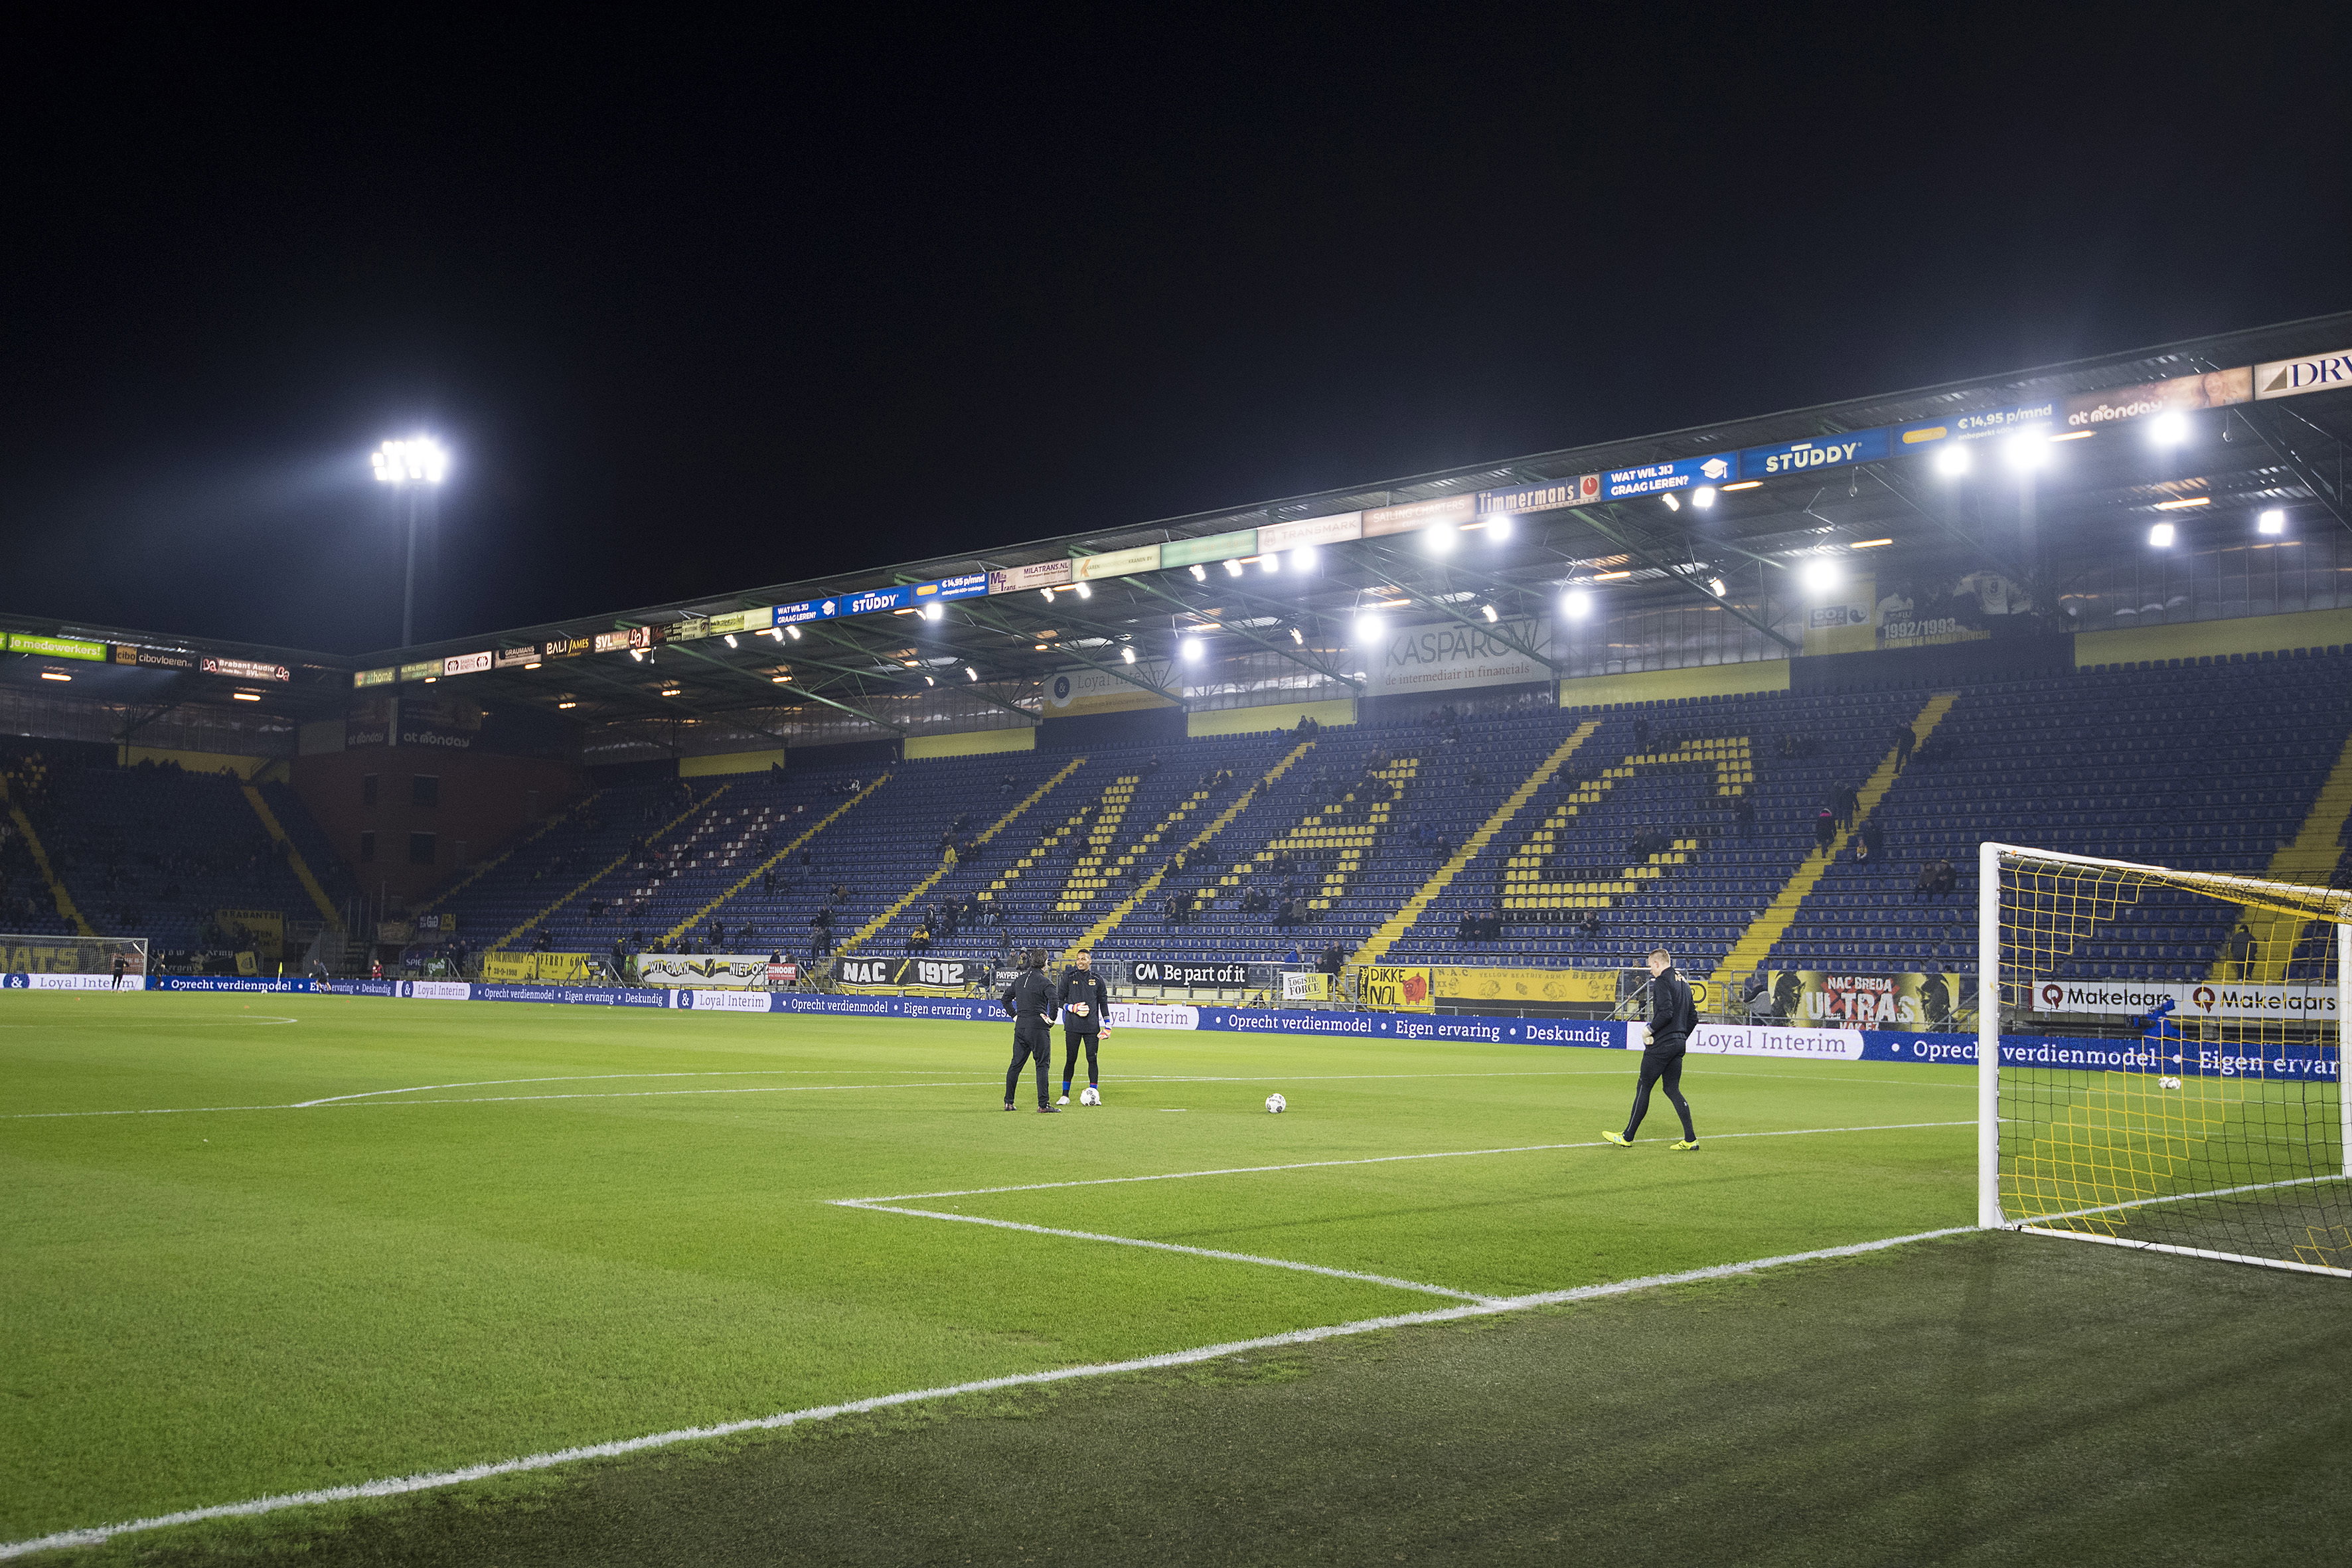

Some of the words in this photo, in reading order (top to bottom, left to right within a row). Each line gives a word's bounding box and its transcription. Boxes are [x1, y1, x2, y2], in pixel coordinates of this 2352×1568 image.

[1969, 412, 2003, 428] 14,95
[2006, 404, 2053, 424] p/mnd
[2069, 412, 2088, 425] at
[2090, 402, 2163, 424] monday
[1611, 471, 1636, 483] WAT
[1637, 467, 1657, 479] WIL
[1658, 465, 1673, 477] JIJ
[1611, 481, 1648, 496] GRAAG
[1649, 475, 1689, 490] LEREN?
[1478, 484, 1574, 513] Timmermans
[1373, 508, 1412, 522] SAILING
[1415, 500, 1465, 516] CHARTERS
[1282, 520, 1357, 539] TRANSMARK
[1024, 562, 1068, 574] MILATRANS.NL
[947, 578, 963, 588] 14,95
[964, 574, 985, 586] p/mnd
[999, 580, 1016, 591] Trans
[777, 606, 790, 615] WAT
[791, 604, 801, 613] WIL
[777, 614, 797, 624] GRAAG
[797, 611, 817, 621] LEREN?
[1883, 617, 1956, 639] 1992/1993
[10, 638, 21, 648] je
[24, 640, 100, 656] medewerkers!
[505, 646, 534, 656] GRAUMANS
[546, 641, 566, 655] BALI
[569, 639, 589, 653] JAMES
[595, 635, 613, 649] SVL
[219, 660, 250, 669] Brabant
[367, 672, 392, 684] athome
[1077, 674, 1111, 692] Loyal
[1385, 675, 1397, 686] de
[1399, 670, 1460, 684] intermediair
[1464, 667, 1474, 678] in
[1478, 663, 1529, 678] financials
[540, 955, 564, 967] FERRY
[648, 961, 663, 973] WIJ
[666, 961, 690, 975] GAAN
[730, 963, 749, 976] NIET
[843, 962, 886, 982] NAC
[917, 961, 964, 982] 1912
[1164, 964, 1181, 980] Be
[1184, 965, 1214, 984] part
[1217, 964, 1233, 981] of
[1234, 965, 1245, 982] it
[1289, 975, 1318, 986] LOGISTIC
[11, 976, 23, 988] &
[40, 977, 77, 990] Loyal
[171, 980, 214, 990] Oprecht
[217, 980, 291, 991] verdienmodel
[332, 983, 354, 994] ervaring
[362, 984, 391, 996] Deskundig
[1290, 982, 1320, 996] FORCE
[1828, 977, 1852, 990] NAC
[1854, 977, 1893, 992] BREDA
[404, 983, 411, 995] &
[418, 984, 436, 998] Loyal
[438, 985, 465, 996] Interim
[485, 988, 510, 1000] Oprecht
[510, 988, 554, 1000] verdienmodel
[565, 990, 583, 1004] Eigen
[585, 991, 614, 1005] ervaring
[625, 992, 663, 1007] Deskundig
[1370, 986, 1401, 1005] NOL
[2067, 988, 2171, 1006] Makelaars
[2221, 991, 2337, 1011] Makelaars
[682, 992, 690, 1006] &
[700, 994, 724, 1010] Loyal
[728, 994, 764, 1008] Interim
[791, 998, 825, 1012] Oprecht
[827, 999, 888, 1013] verdienmodel
[903, 1002, 929, 1017] Eigen
[931, 1003, 972, 1020] ervaring
[1806, 991, 1916, 1023] ULTRAS
[1136, 1008, 1188, 1026] Interim
[1229, 1013, 1279, 1030] Oprecht
[1282, 1015, 1372, 1033] verdienmodel
[1395, 1020, 1433, 1038] Eigen
[1438, 1022, 1500, 1042] ervaring
[1526, 1025, 1610, 1047] Deskundig
[1695, 1030, 1752, 1053] Loyal
[1762, 1032, 1846, 1053] Interim
[1913, 1040, 1979, 1062] Oprec
[2003, 1044, 2157, 1067] verdienmodel
[2199, 1051, 2264, 1075] Eigen
[2273, 1055, 2341, 1075] ervar
